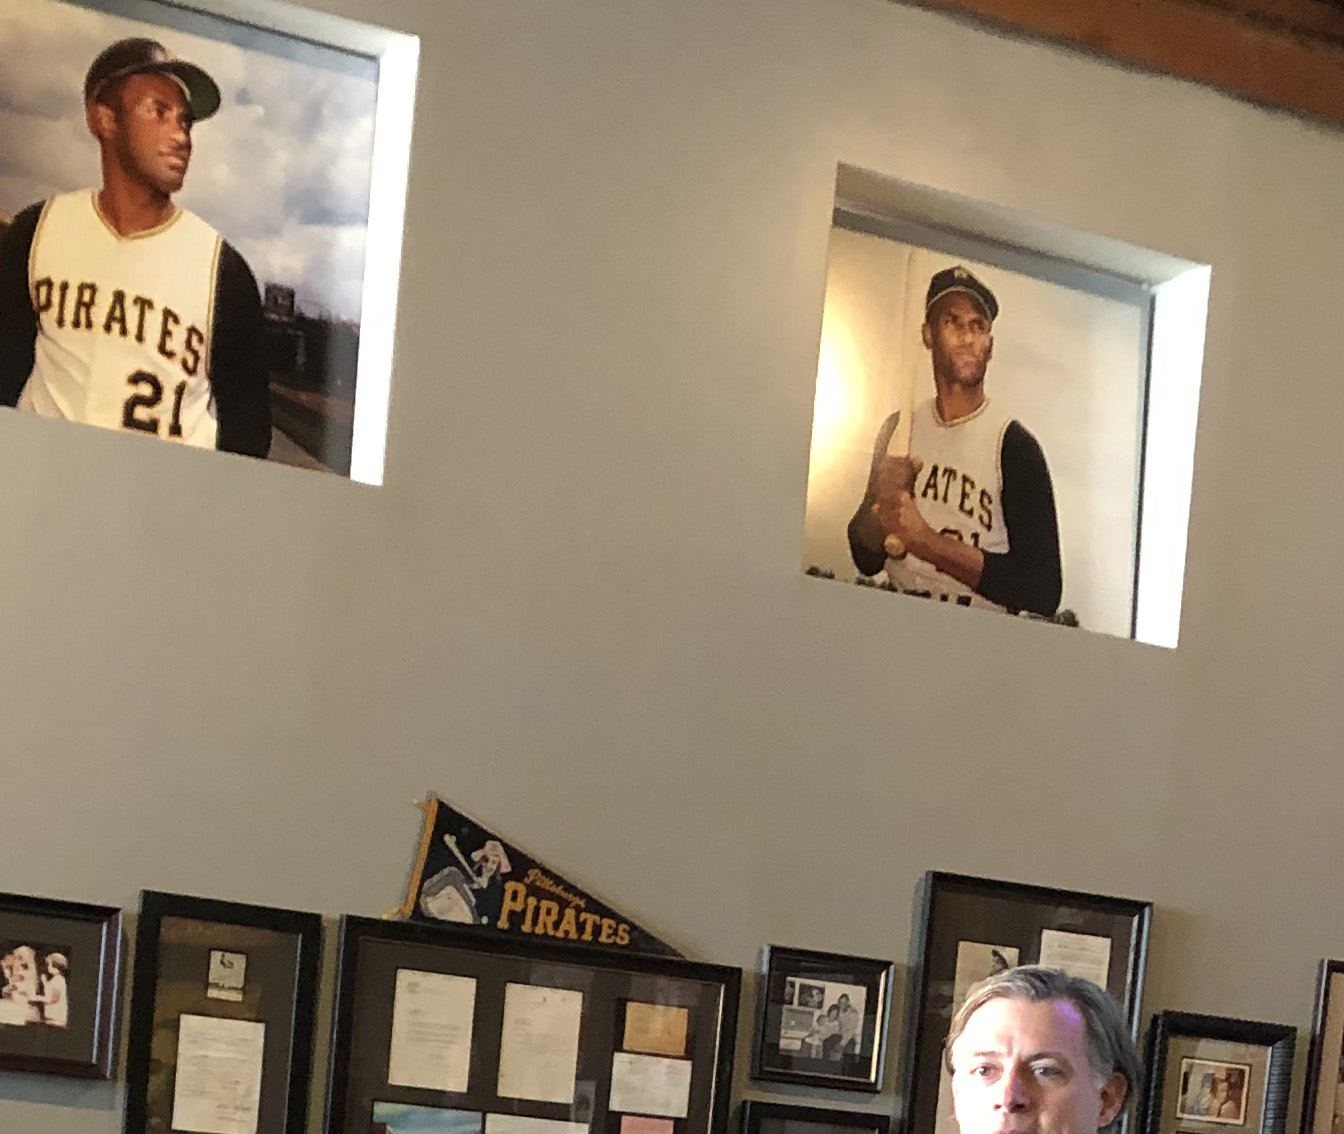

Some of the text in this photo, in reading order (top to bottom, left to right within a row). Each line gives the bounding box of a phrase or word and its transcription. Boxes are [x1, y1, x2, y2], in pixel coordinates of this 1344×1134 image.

[33, 275, 205, 378] PIRATES
[121, 369, 188, 437] 21
[910, 462, 993, 533] ATES
[496, 880, 632, 945] PIRATES
